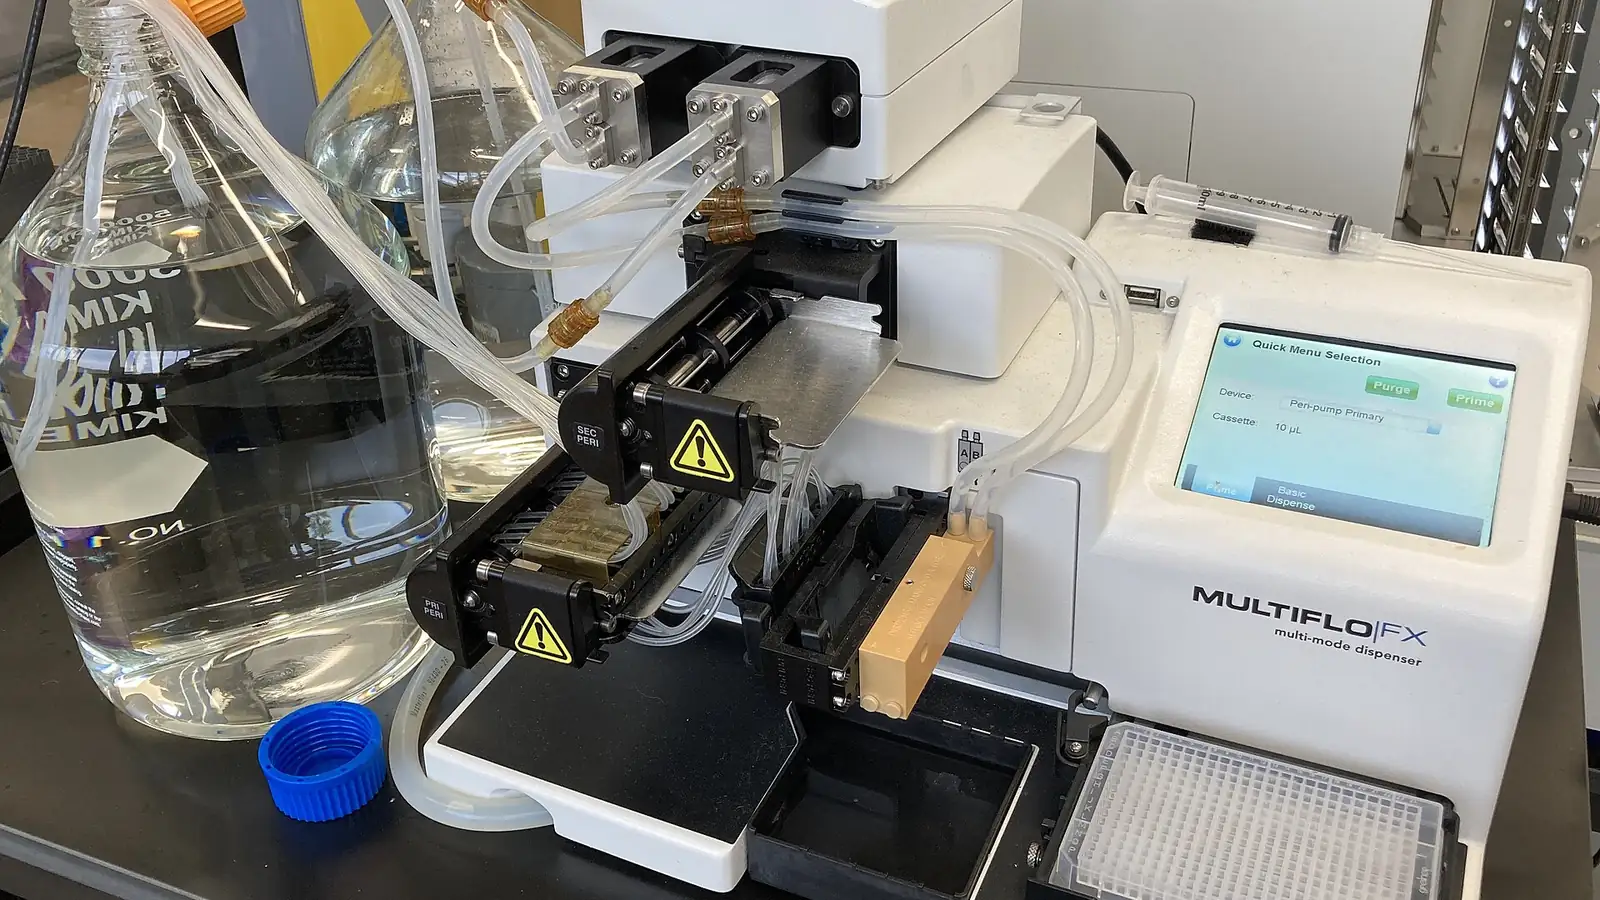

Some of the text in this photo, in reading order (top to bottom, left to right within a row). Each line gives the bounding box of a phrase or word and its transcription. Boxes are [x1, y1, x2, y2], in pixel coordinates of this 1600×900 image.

[1252, 340, 1381, 367] Quick Menu Selection
[1373, 381, 1411, 396] Purge
[1219, 387, 1385, 424] Device: Peri-pump Primary
[1456, 394, 1495, 408] Prime
[1212, 412, 1258, 427] Cassette:
[1275, 423, 1287, 432] 10
[577, 425, 597, 438] SEC
[576, 434, 599, 448] PERI
[960, 448, 980, 460] A B
[1278, 486, 1307, 499] Basic
[1266, 494, 1316, 511] Dispense
[425, 600, 440, 611] PRI
[424, 606, 444, 620] PERI
[1274, 628, 1422, 667] multi-mode dispenser
